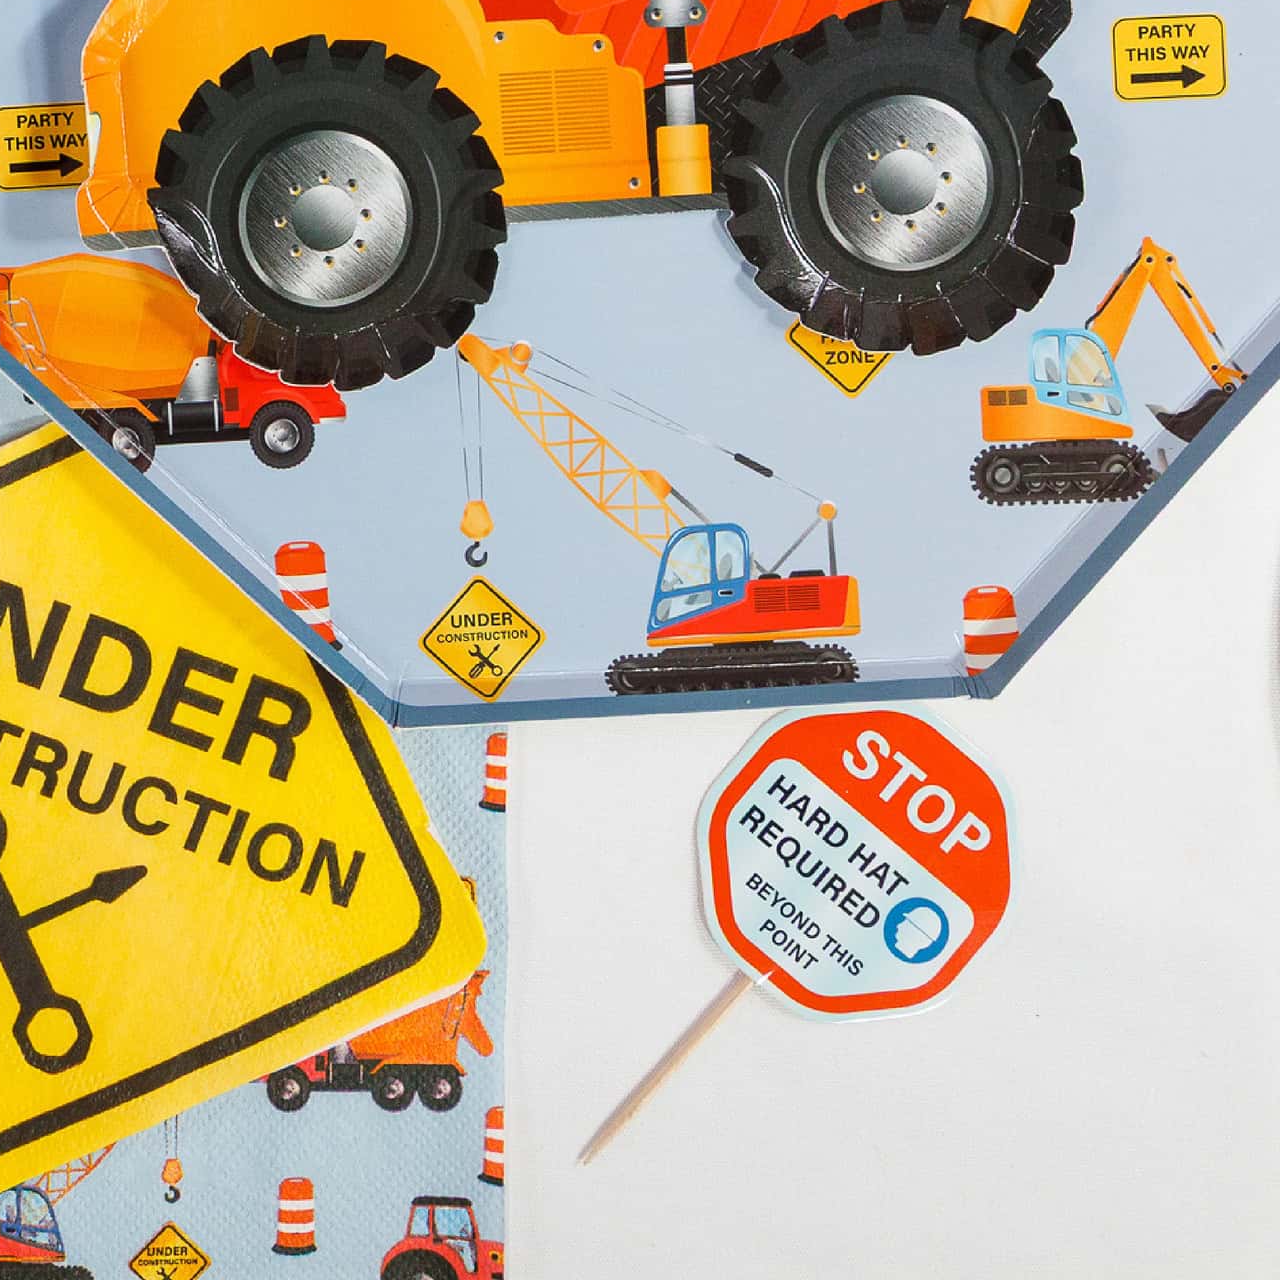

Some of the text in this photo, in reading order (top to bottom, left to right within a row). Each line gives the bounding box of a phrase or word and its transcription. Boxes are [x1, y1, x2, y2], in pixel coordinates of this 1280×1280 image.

[1138, 23, 1196, 39] PARTY
[1125, 44, 1210, 62] THIS WAY
[16, 112, 74, 128] PARTY
[4, 133, 88, 151] THIS WAY
[825, 350, 875, 365] ZONE
[451, 612, 513, 628] UNDER
[437, 630, 528, 643] CONSTRUCTION
[842, 730, 992, 854] STOP
[767, 775, 910, 896] HARD HAT
[739, 804, 880, 929] REQUIRED
[745, 873, 864, 976] BEYOND THIS
[758, 919, 819, 971] POINT
[147, 1246, 188, 1257] UNDER
